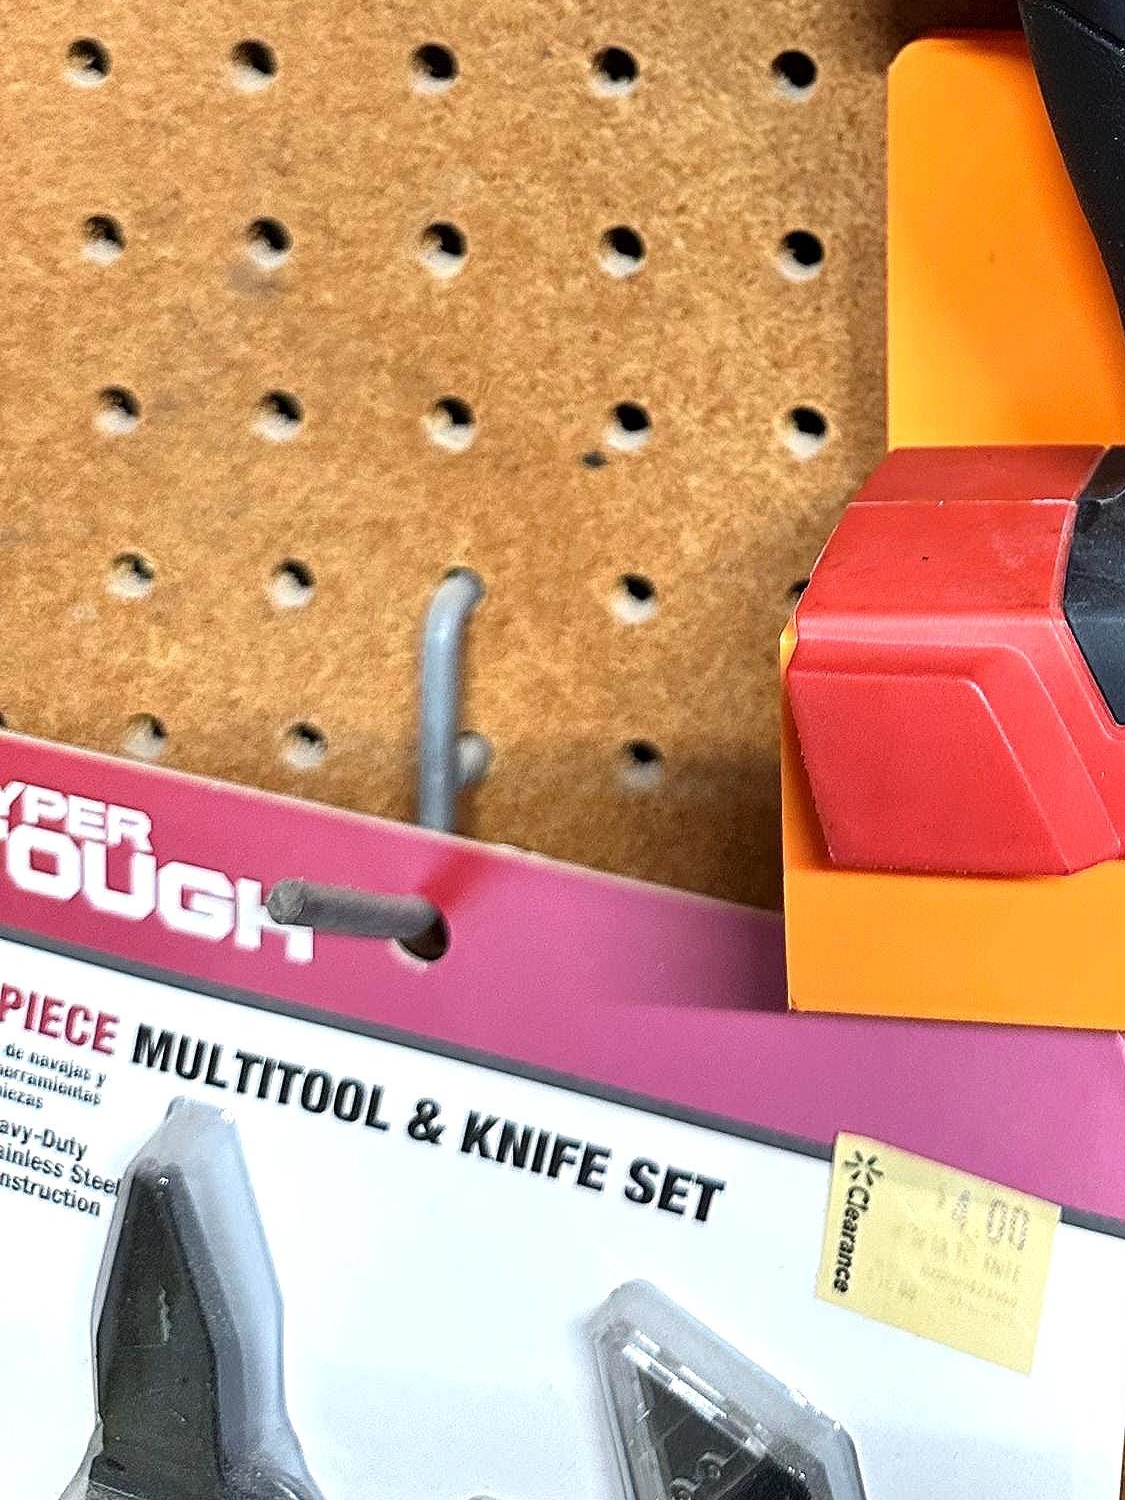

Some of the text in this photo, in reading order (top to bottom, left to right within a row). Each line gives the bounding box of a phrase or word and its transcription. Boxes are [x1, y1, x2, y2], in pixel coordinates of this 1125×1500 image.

[0, 817, 315, 964] OUGH
[0, 1082, 44, 1110] iezas
[0, 982, 727, 1223] PIECE MULTITOOL & KNIFE SET
[29, 1051, 92, 1081] navajas
[96, 1072, 107, 1088] y
[70, 1163, 122, 1198] Steel
[833, 1185, 870, 1293] Clearance
